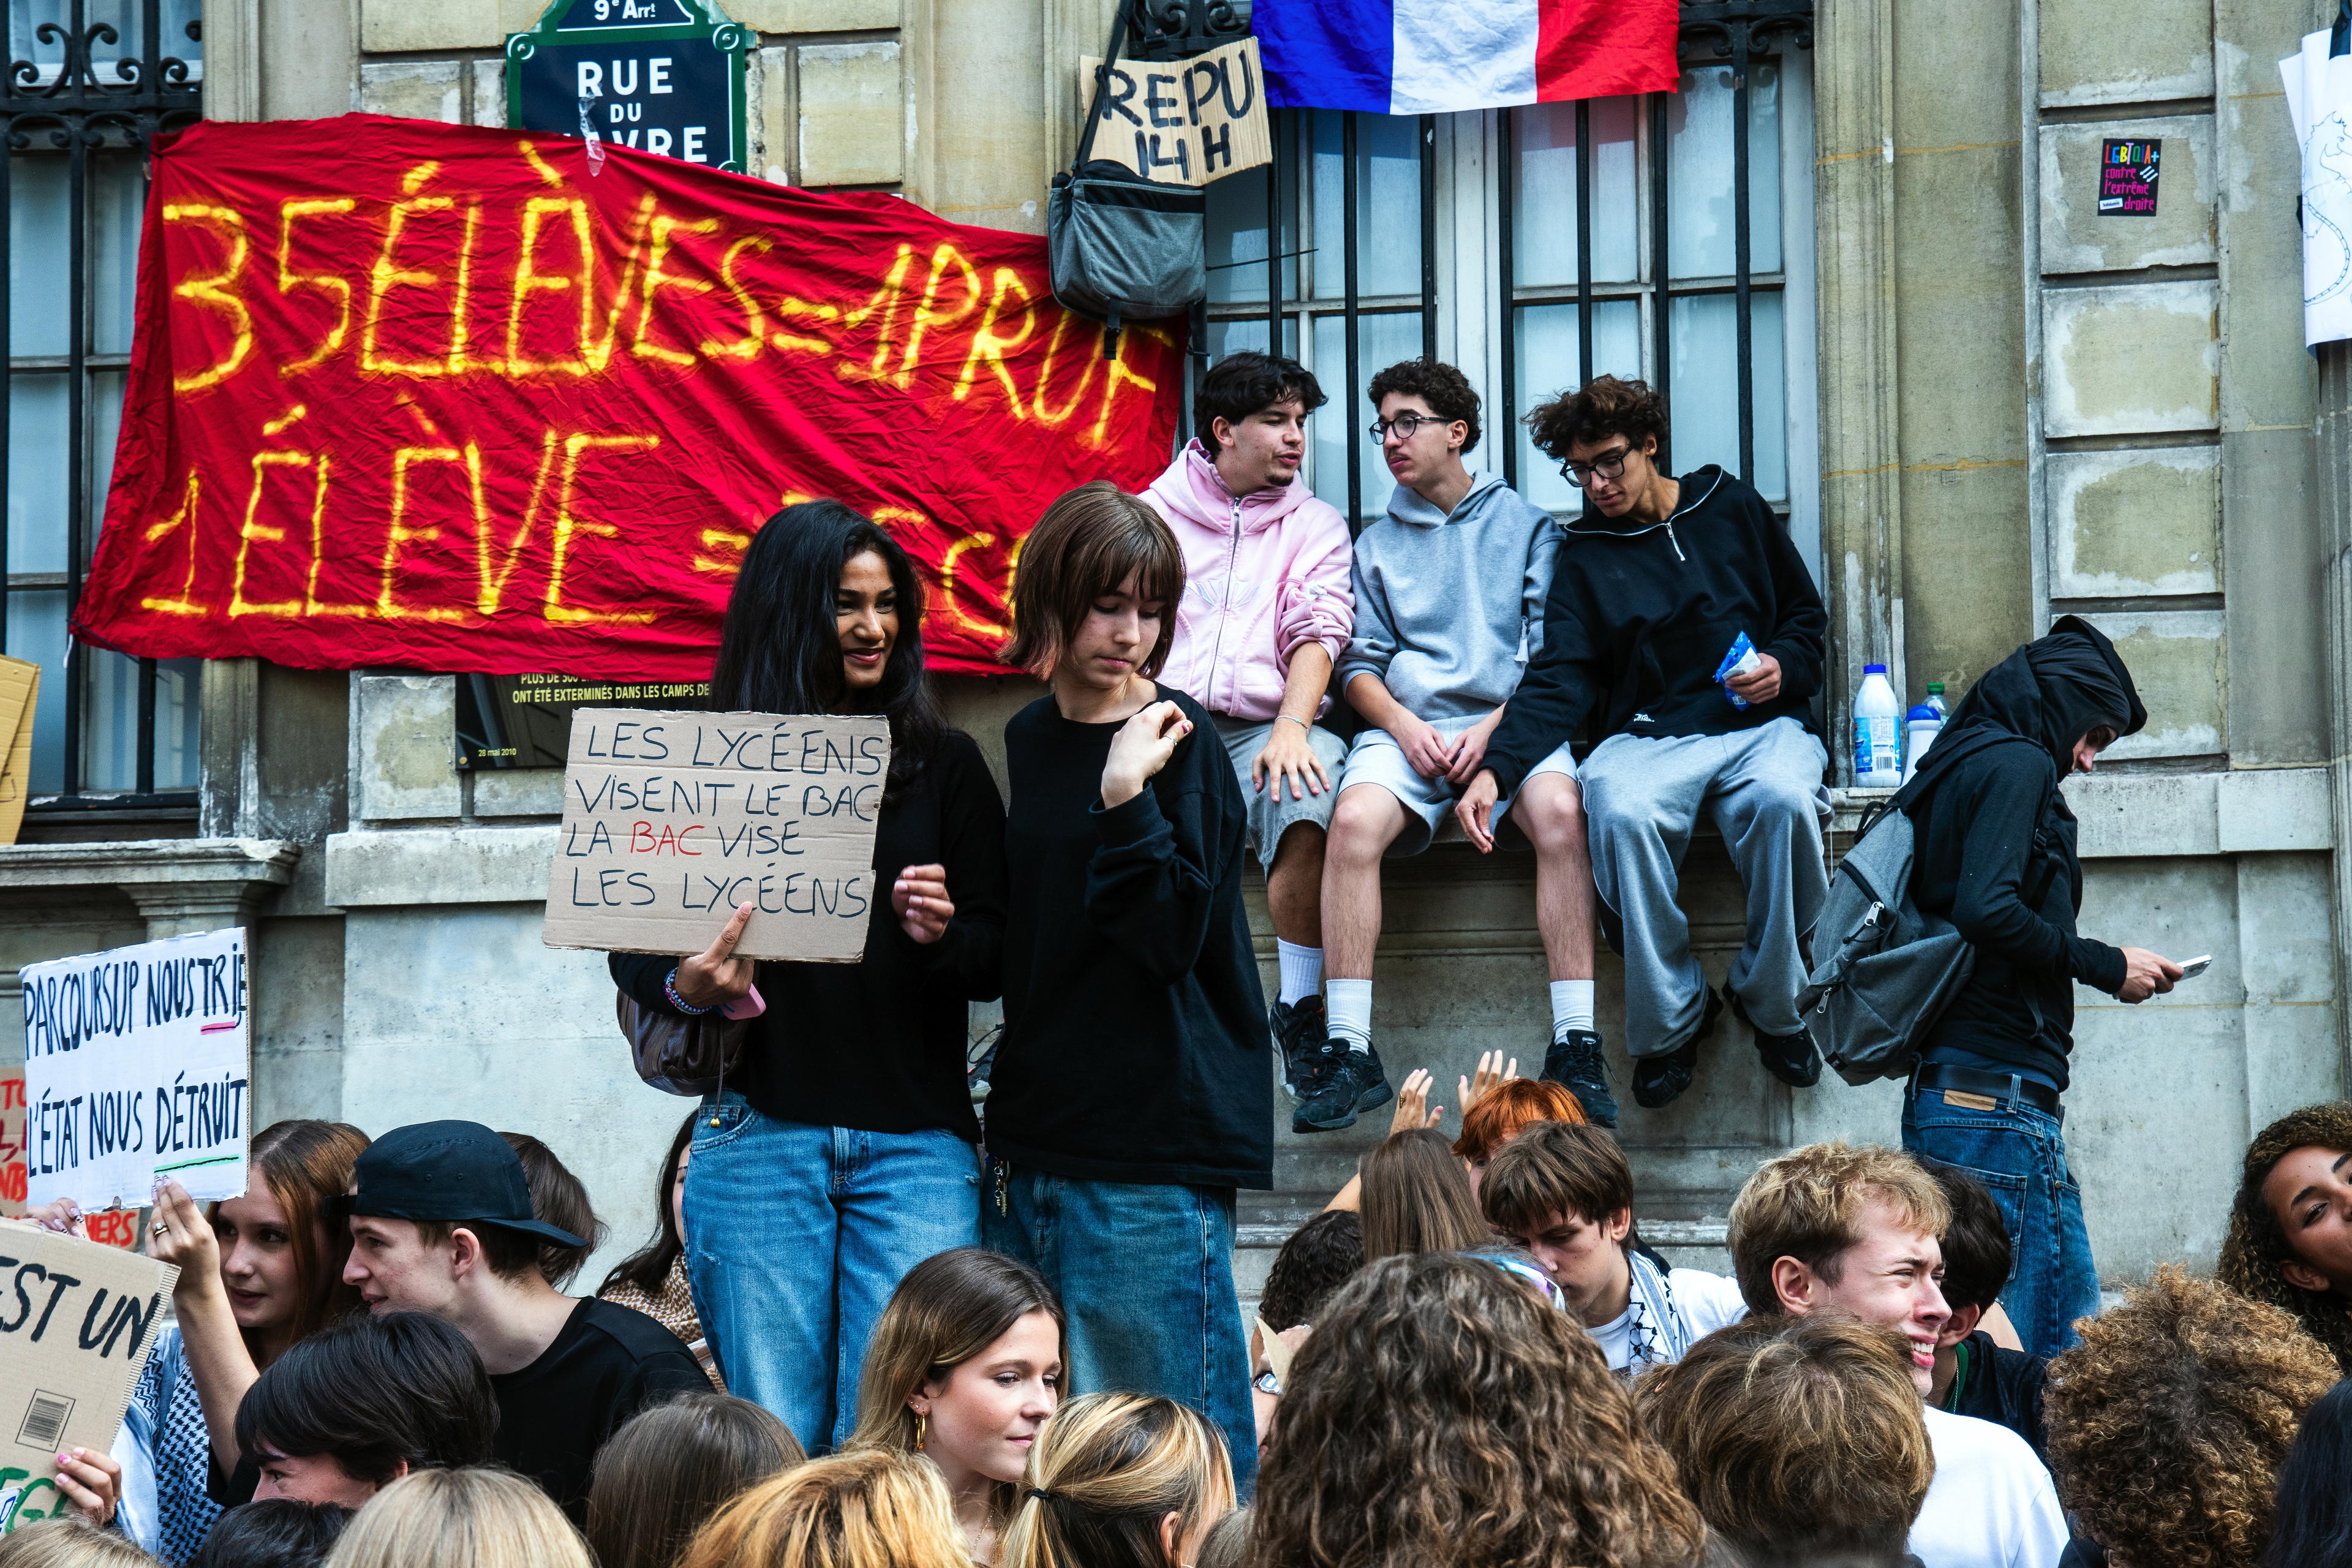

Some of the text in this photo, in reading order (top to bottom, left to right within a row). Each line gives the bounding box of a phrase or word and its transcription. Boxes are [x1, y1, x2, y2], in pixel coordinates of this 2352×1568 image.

[578, 58, 673, 97] RUE
[1095, 50, 1254, 127] REPU
[611, 103, 641, 123] DU
[2104, 178, 2149, 195] l'extrême
[2105, 166, 2136, 179] contre
[2124, 196, 2154, 211] droite
[140, 469, 208, 615] 1
[228, 393, 661, 624] ÉLÈVE
[513, 690, 531, 704] ONT
[534, 687, 551, 703] ÉTÉ
[554, 685, 612, 701] EXTERMINÉS
[615, 686, 641, 699] DANS
[643, 685, 659, 698] LES
[662, 684, 695, 698] CAMPS
[587, 722, 883, 775] LES LYCÉENS
[745, 783, 790, 817] LE
[802, 783, 879, 822] BAC
[566, 820, 612, 857] LA
[630, 821, 705, 856] BAC
[573, 862, 867, 918] LES LYCÉENS
[23, 960, 139, 1060] PARCOURSUP
[146, 957, 195, 1027] NOUS
[29, 1087, 83, 1178] L'ÉTAT
[89, 1090, 142, 1160] NOUS
[78, 1287, 160, 1360] UN
